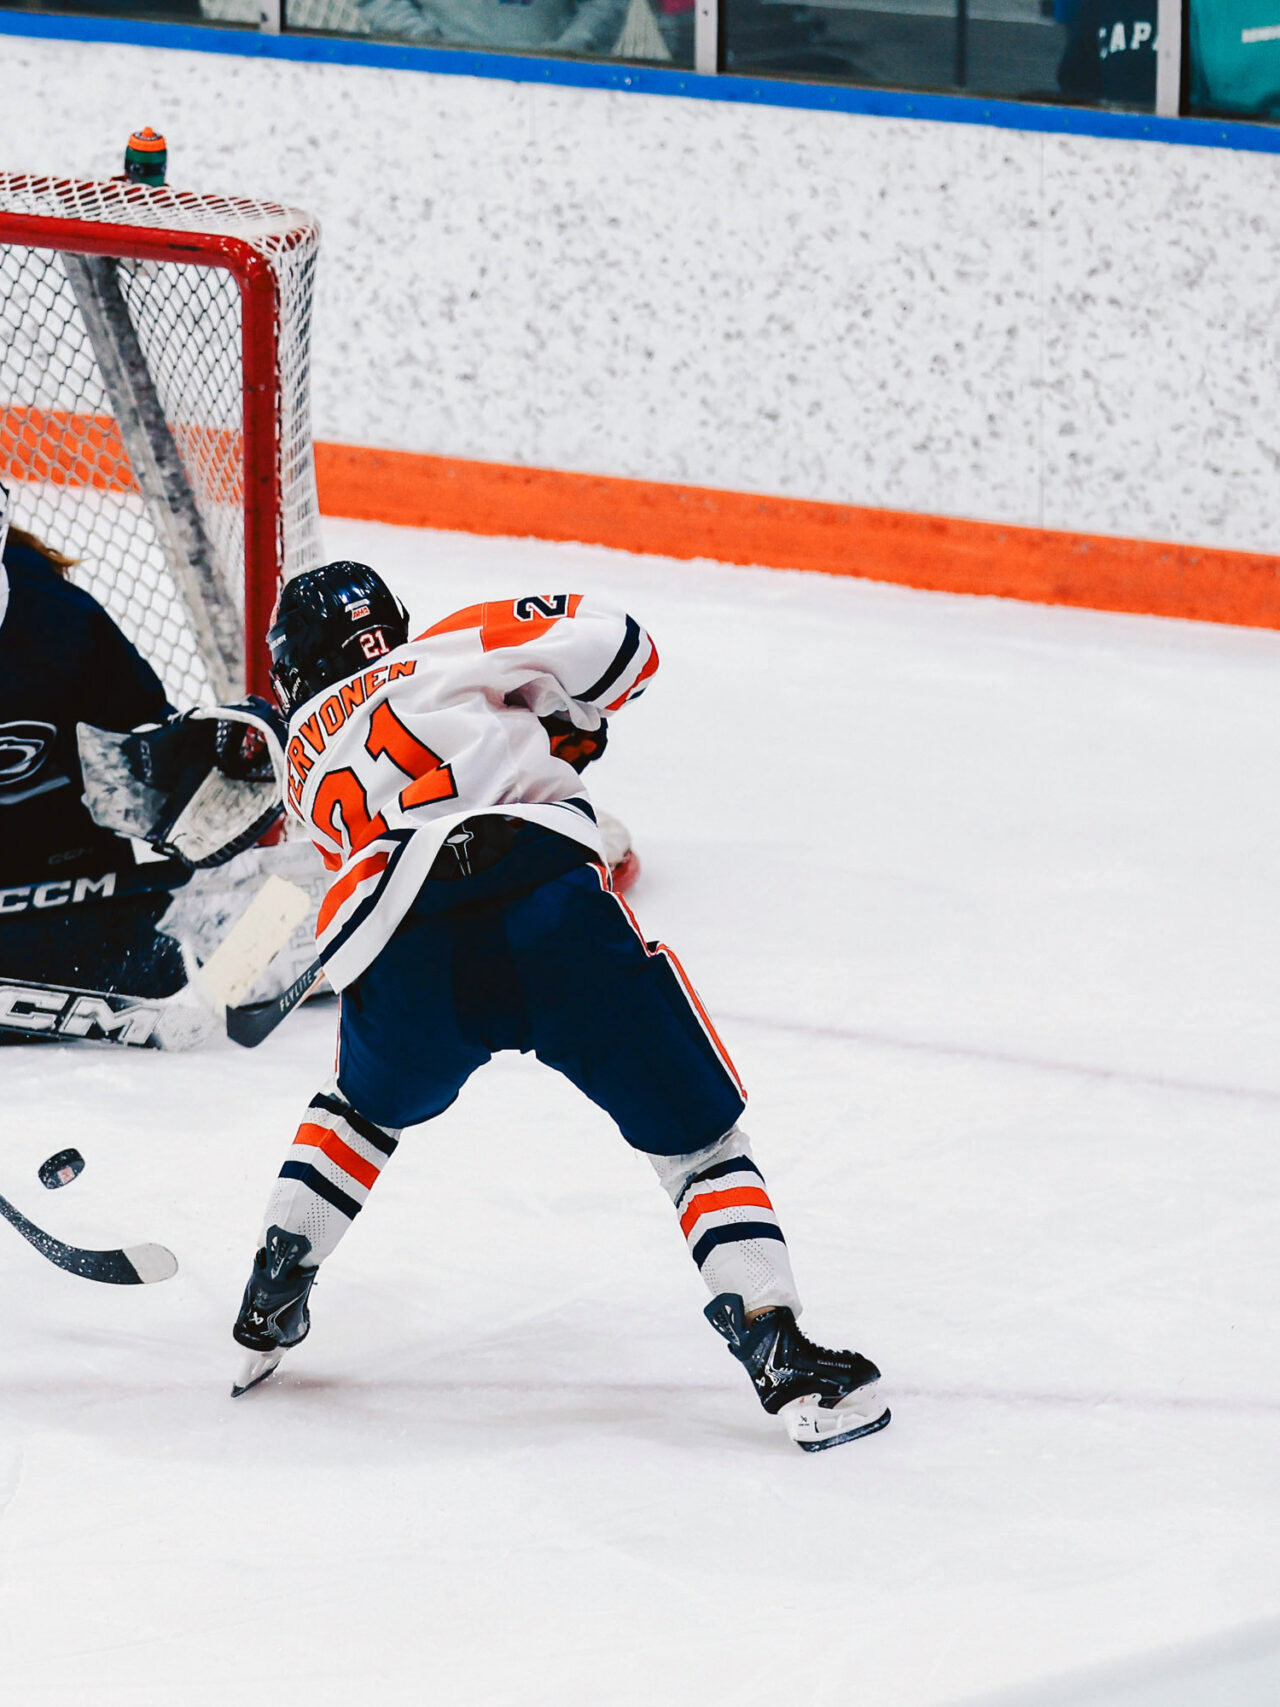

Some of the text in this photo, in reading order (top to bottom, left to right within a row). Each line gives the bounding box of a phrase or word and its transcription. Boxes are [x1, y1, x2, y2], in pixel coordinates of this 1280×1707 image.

[359, 629, 390, 660] 21
[311, 698, 459, 872] 21
[279, 969, 313, 1013] FLYLITE
